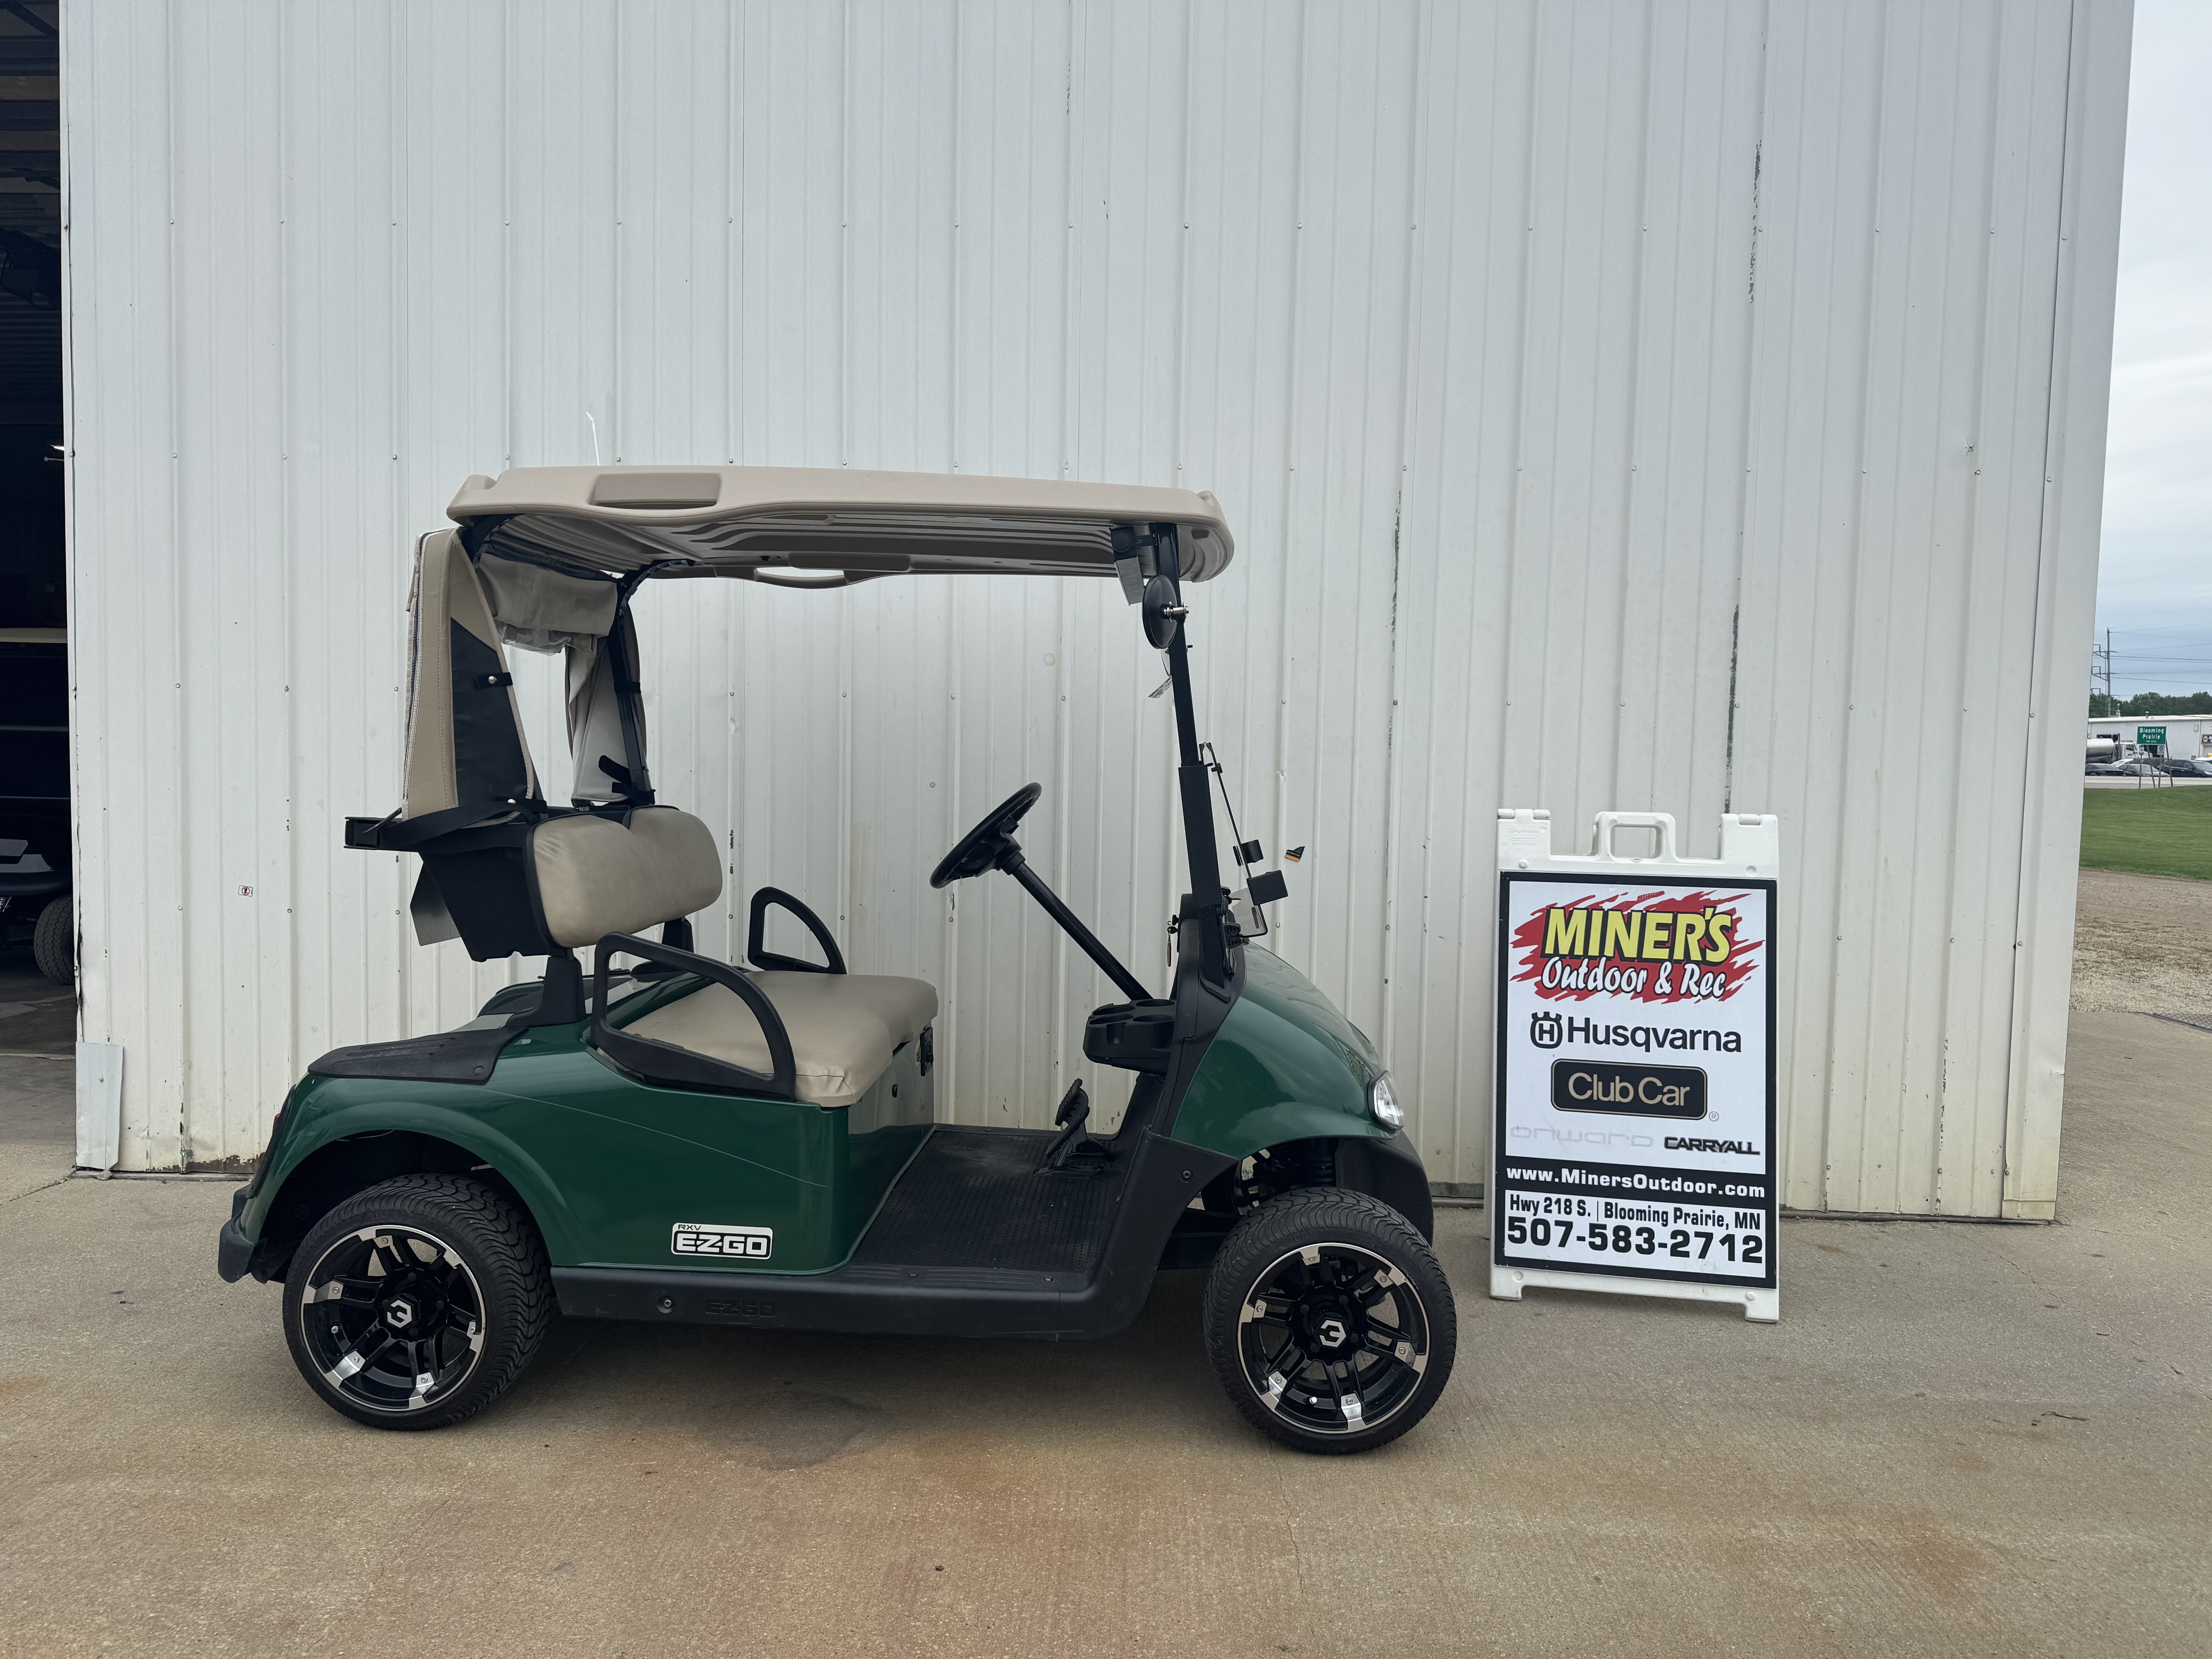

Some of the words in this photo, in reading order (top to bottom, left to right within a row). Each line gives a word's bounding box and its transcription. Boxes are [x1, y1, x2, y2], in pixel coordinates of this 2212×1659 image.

[1542, 906, 1733, 963] MINER'S
[1542, 957, 1647, 993] Outdoor
[1654, 962, 1672, 995] &
[1680, 963, 1726, 996] Rec
[1568, 1016, 1741, 1053] Husqvarna
[1568, 1072, 1634, 1103] Club
[1638, 1077, 1690, 1106] Car
[1664, 1136, 1760, 1155] CARRYALL
[1506, 1168, 1765, 1198] www.MinersOutdoor.com
[1510, 1194, 1539, 1216] Hwy
[1544, 1197, 1572, 1215] 218
[1577, 1201, 1590, 1217] S.
[1604, 1202, 1668, 1227] Blooming
[1673, 1207, 1729, 1230] Prairie,
[1735, 1211, 1760, 1230] MN
[1508, 1216, 1763, 1264] 507-583-2712
